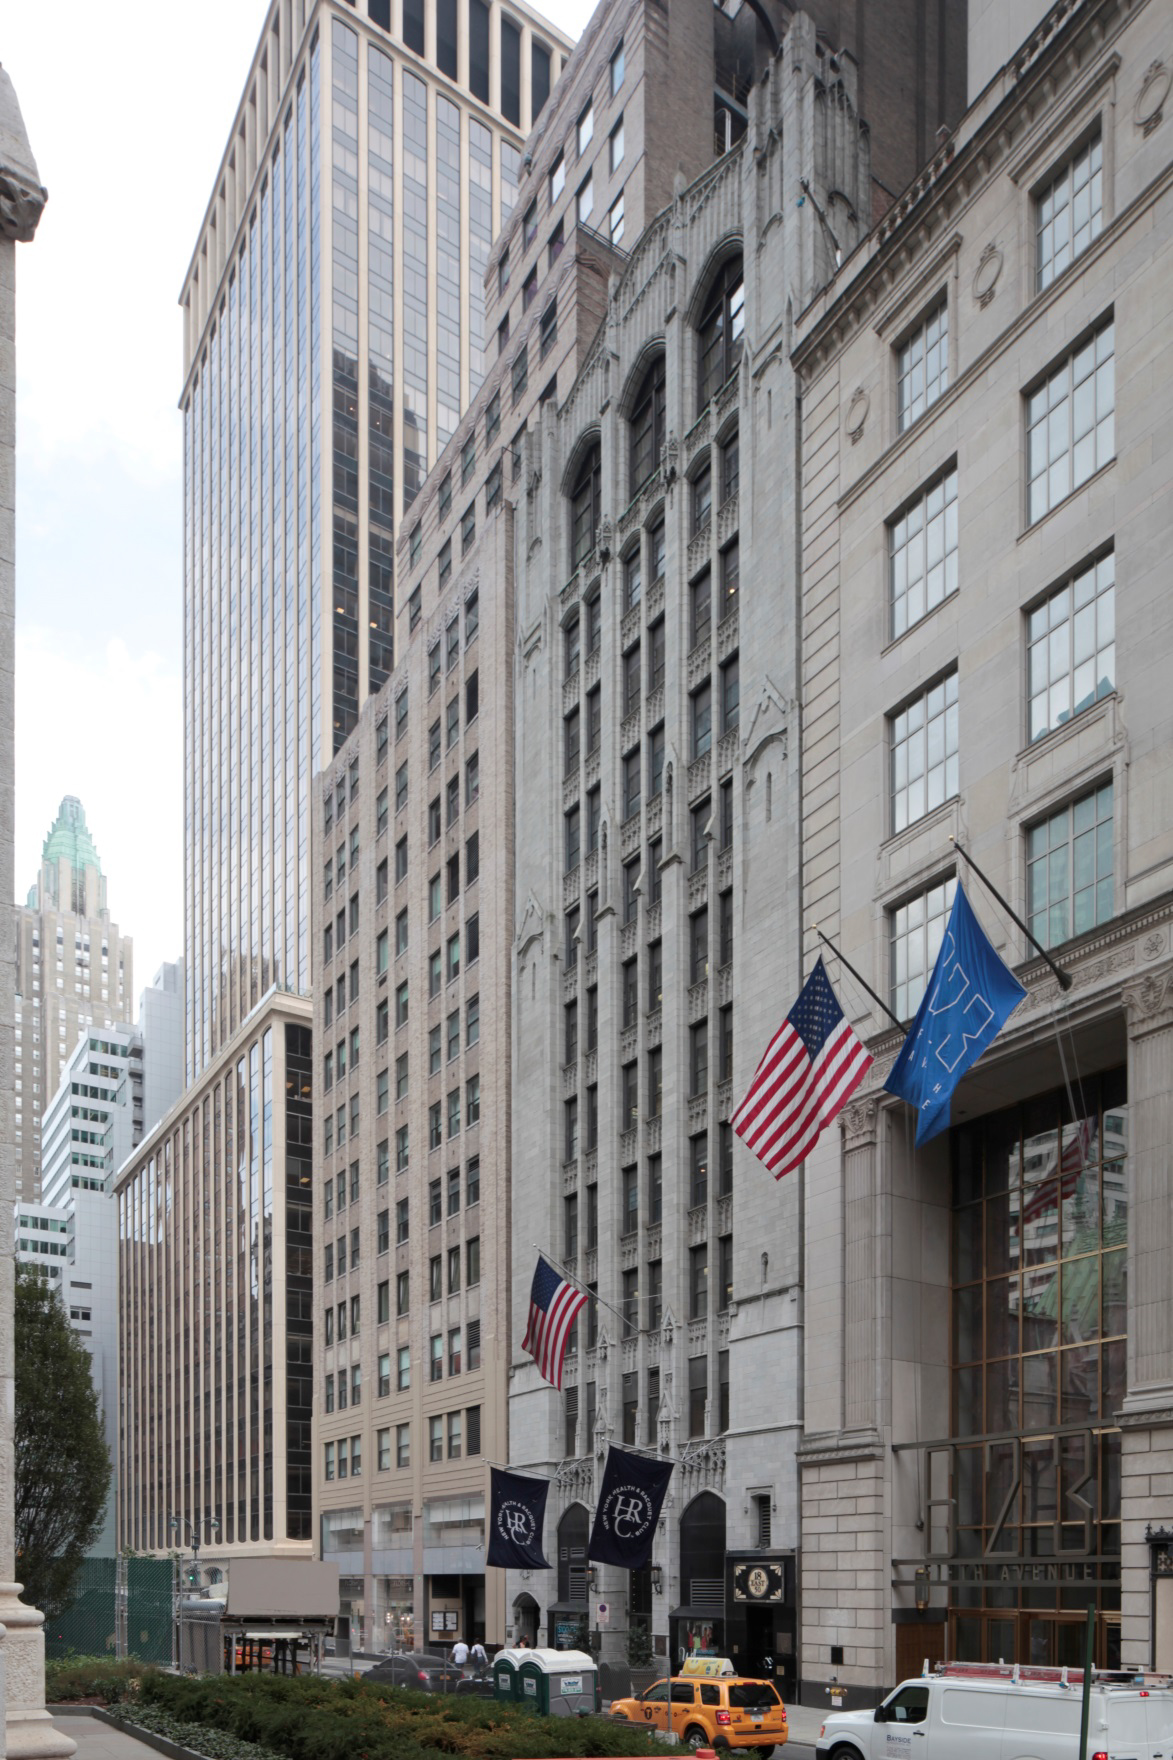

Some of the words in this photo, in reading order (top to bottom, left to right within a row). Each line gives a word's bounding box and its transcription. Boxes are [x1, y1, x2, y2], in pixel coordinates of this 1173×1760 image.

[612, 1485, 636, 1496] HEALTH
[924, 1429, 1093, 1558] 623
[603, 1494, 614, 1513] YORK
[640, 1490, 653, 1520] RACQUET
[521, 1505, 536, 1530] RACQUET
[602, 1515, 610, 1530] NEW
[635, 1521, 650, 1537] CLUB
[754, 1571, 762, 1580] 18
[1001, 1563, 1092, 1580] AVENUE
